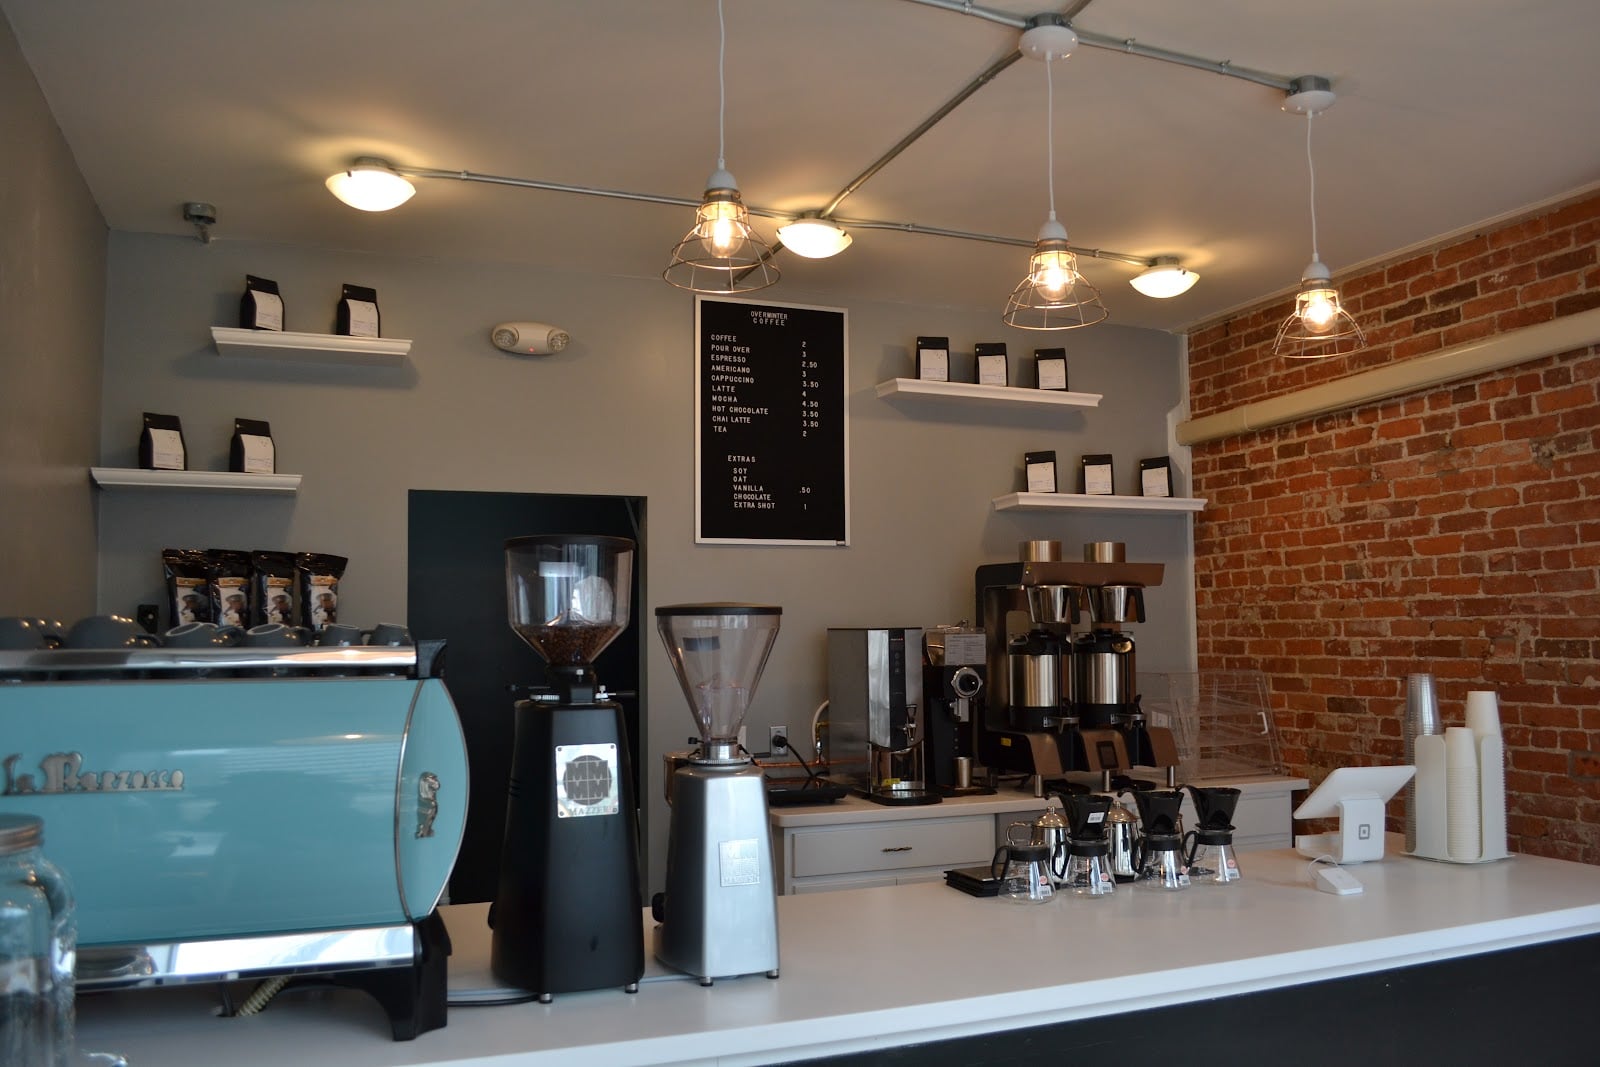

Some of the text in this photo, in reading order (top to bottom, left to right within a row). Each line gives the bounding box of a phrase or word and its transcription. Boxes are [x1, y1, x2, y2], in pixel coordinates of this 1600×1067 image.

[752, 318, 785, 326] COFFEE
[710, 334, 736, 342] COFFEE
[711, 354, 746, 363] ESPRESSO
[712, 365, 750, 373] AMERICANO
[712, 375, 754, 383] CAPPUCCINO
